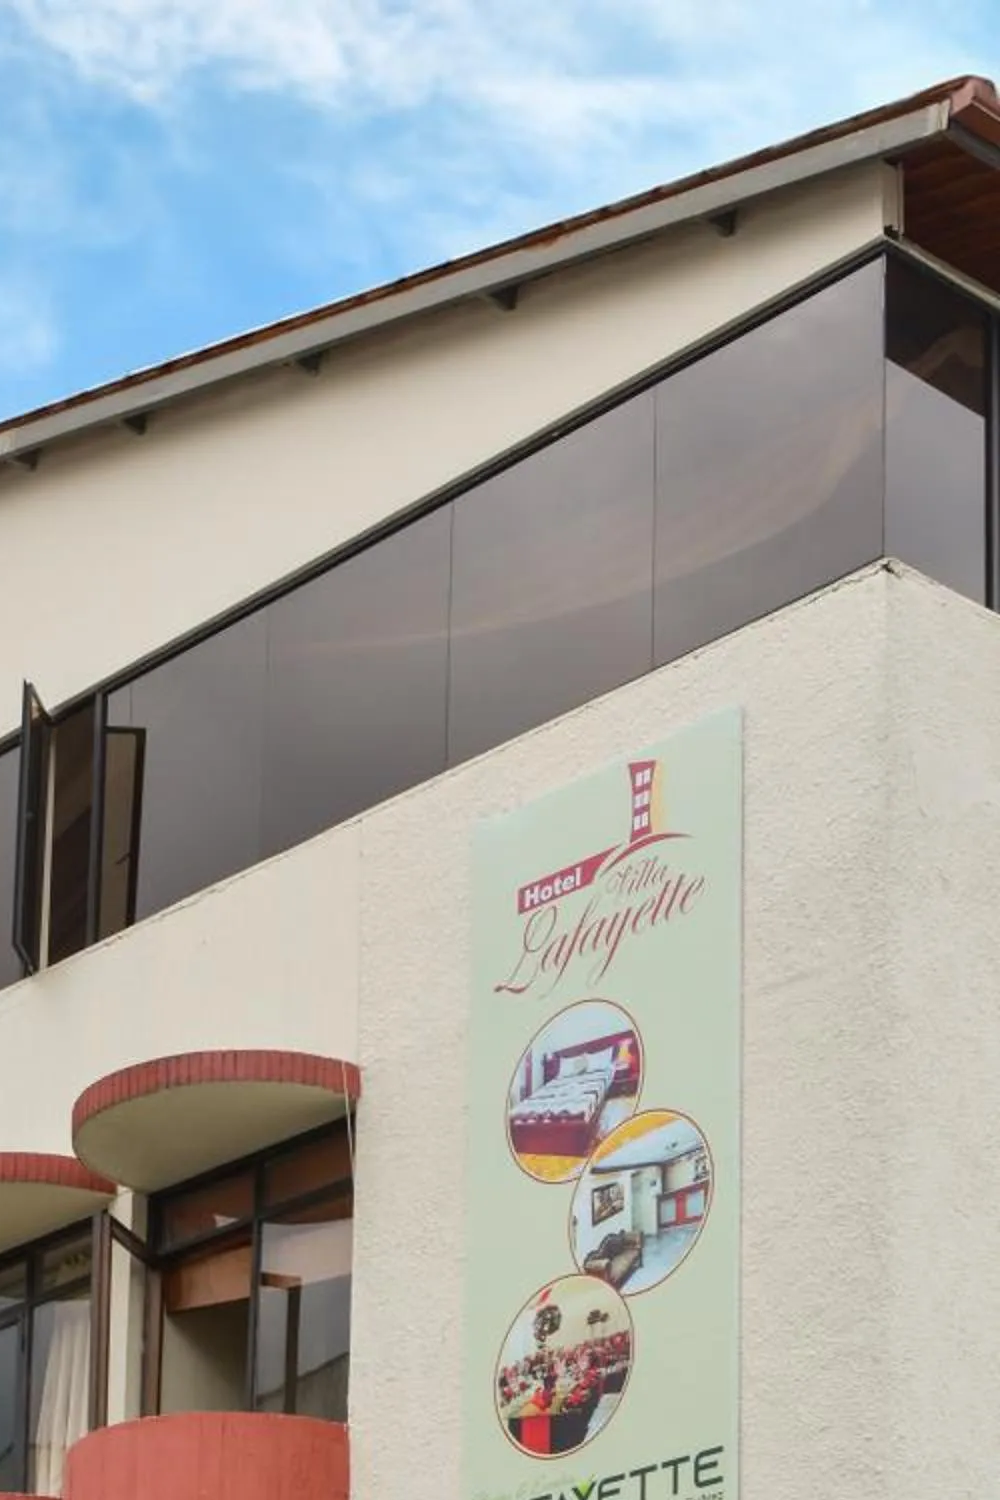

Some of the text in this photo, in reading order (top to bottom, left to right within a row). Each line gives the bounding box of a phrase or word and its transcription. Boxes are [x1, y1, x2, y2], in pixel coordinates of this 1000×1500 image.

[523, 866, 581, 909] Hotel
[605, 856, 667, 897] Villa
[494, 872, 707, 1000] Lafayette
